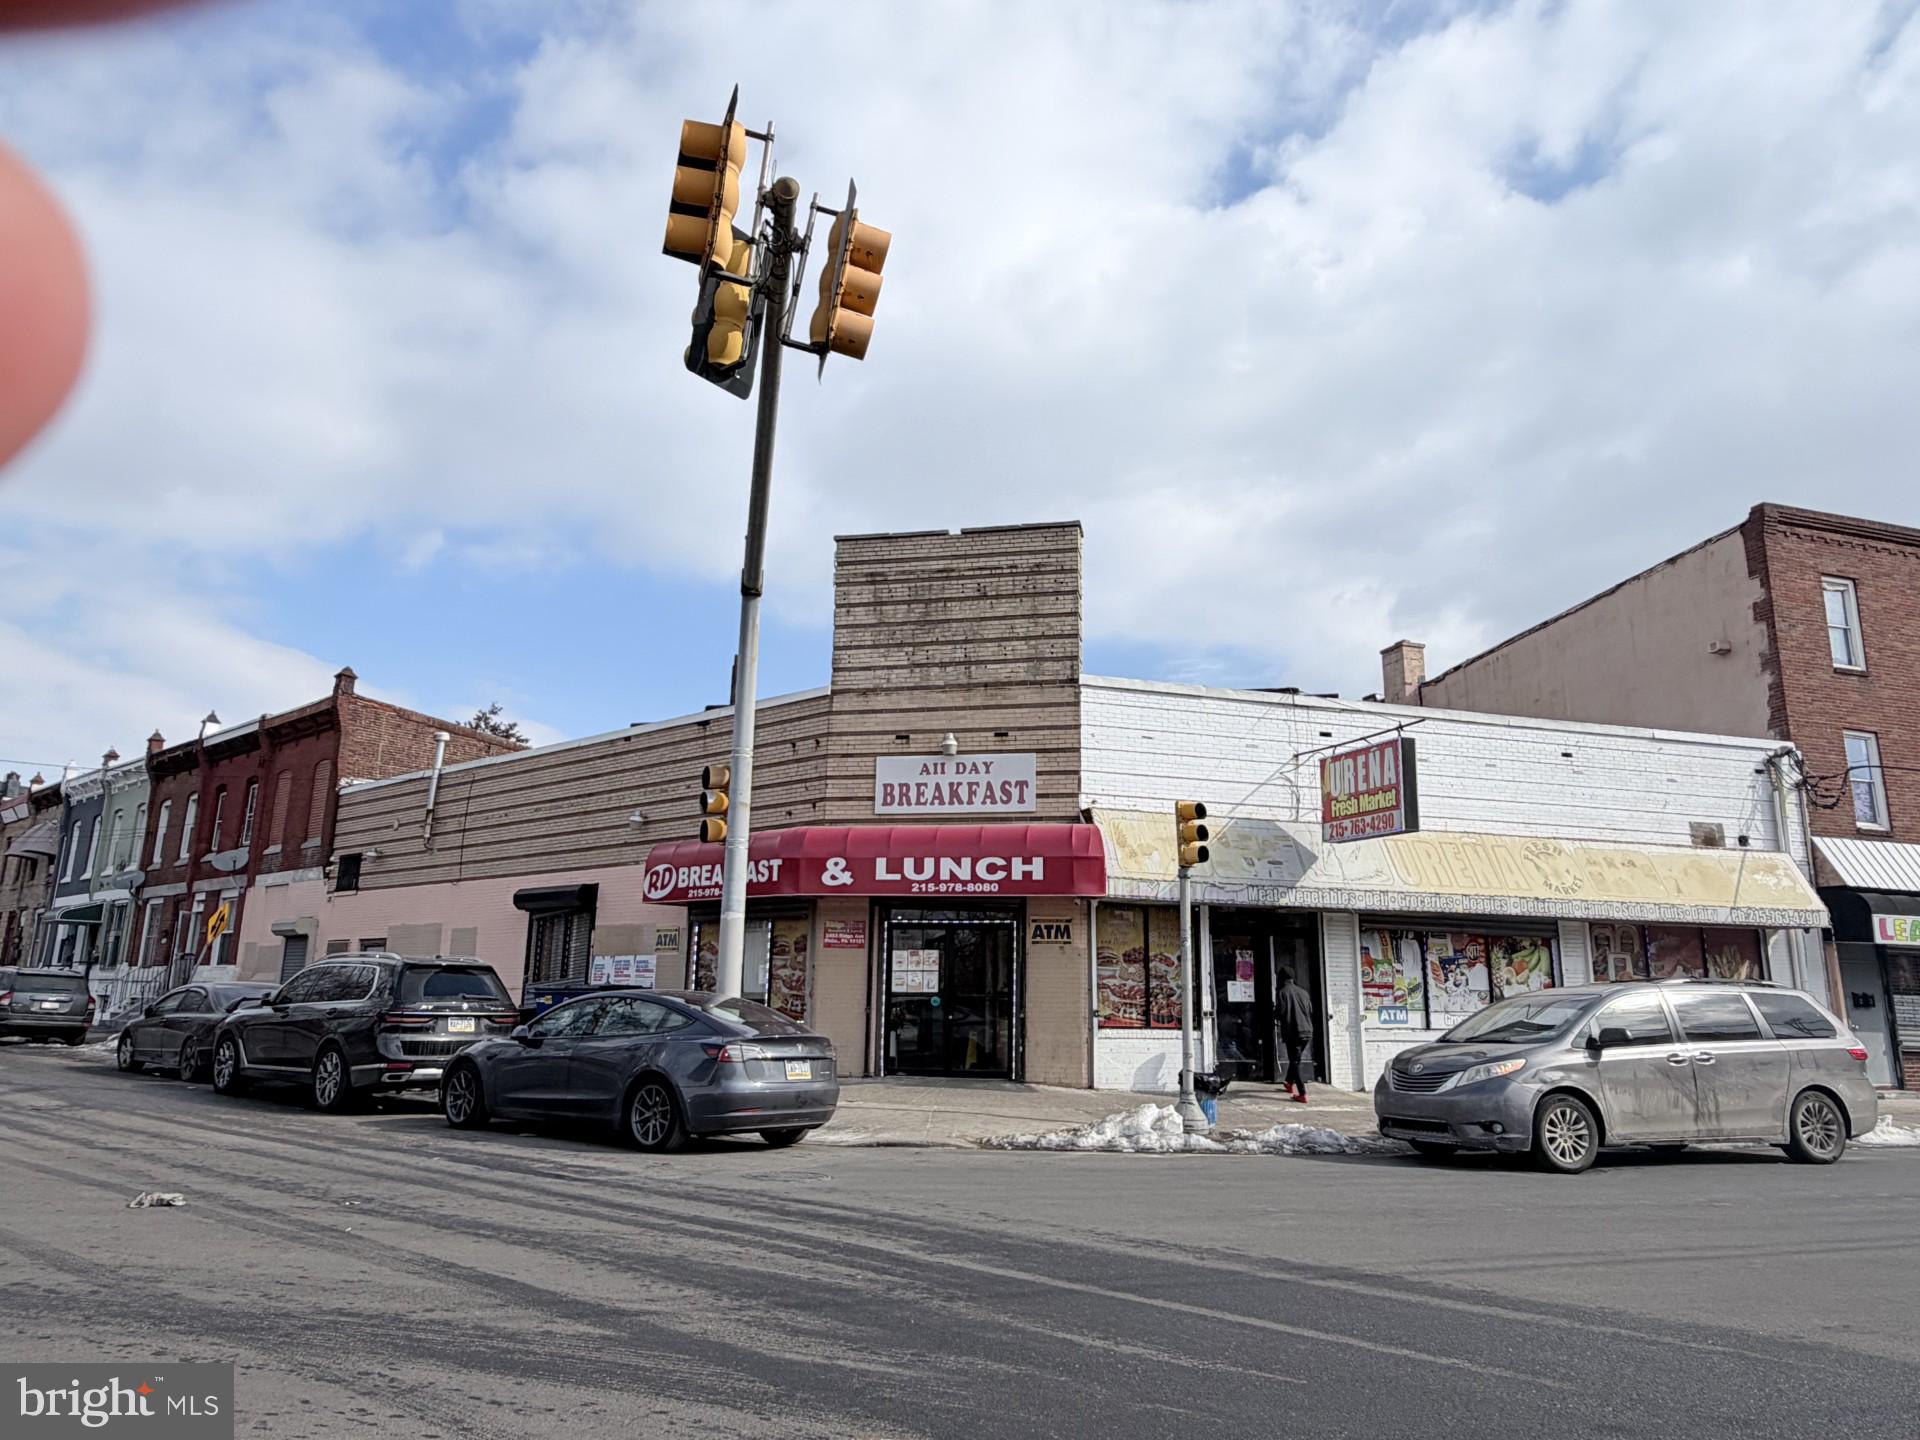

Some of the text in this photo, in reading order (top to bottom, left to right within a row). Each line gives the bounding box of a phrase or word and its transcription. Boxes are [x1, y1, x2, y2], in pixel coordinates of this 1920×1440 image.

[955, 761, 994, 775] DAY
[1329, 747, 1397, 796] UREÑA
[881, 780, 1029, 807] BREAKFAST
[1331, 788, 1396, 817] Fresh Market
[677, 857, 1044, 888] BREAAST & LUNCH
[911, 883, 999, 892] 215-978-8080
[1248, 886, 1279, 902] Meat
[1288, 888, 1356, 906] Vegetables
[1366, 891, 1388, 906] Deli
[1397, 893, 1456, 909] Groceries
[1463, 895, 1508, 912] Hoagies
[1521, 898, 1573, 915] Detergent
[1581, 903, 1614, 917] Candy
[1621, 905, 1648, 919] Soda
[656, 934, 678, 947] ATM
[1032, 925, 1071, 939] ATM
[1380, 1009, 1407, 1020] ATM
